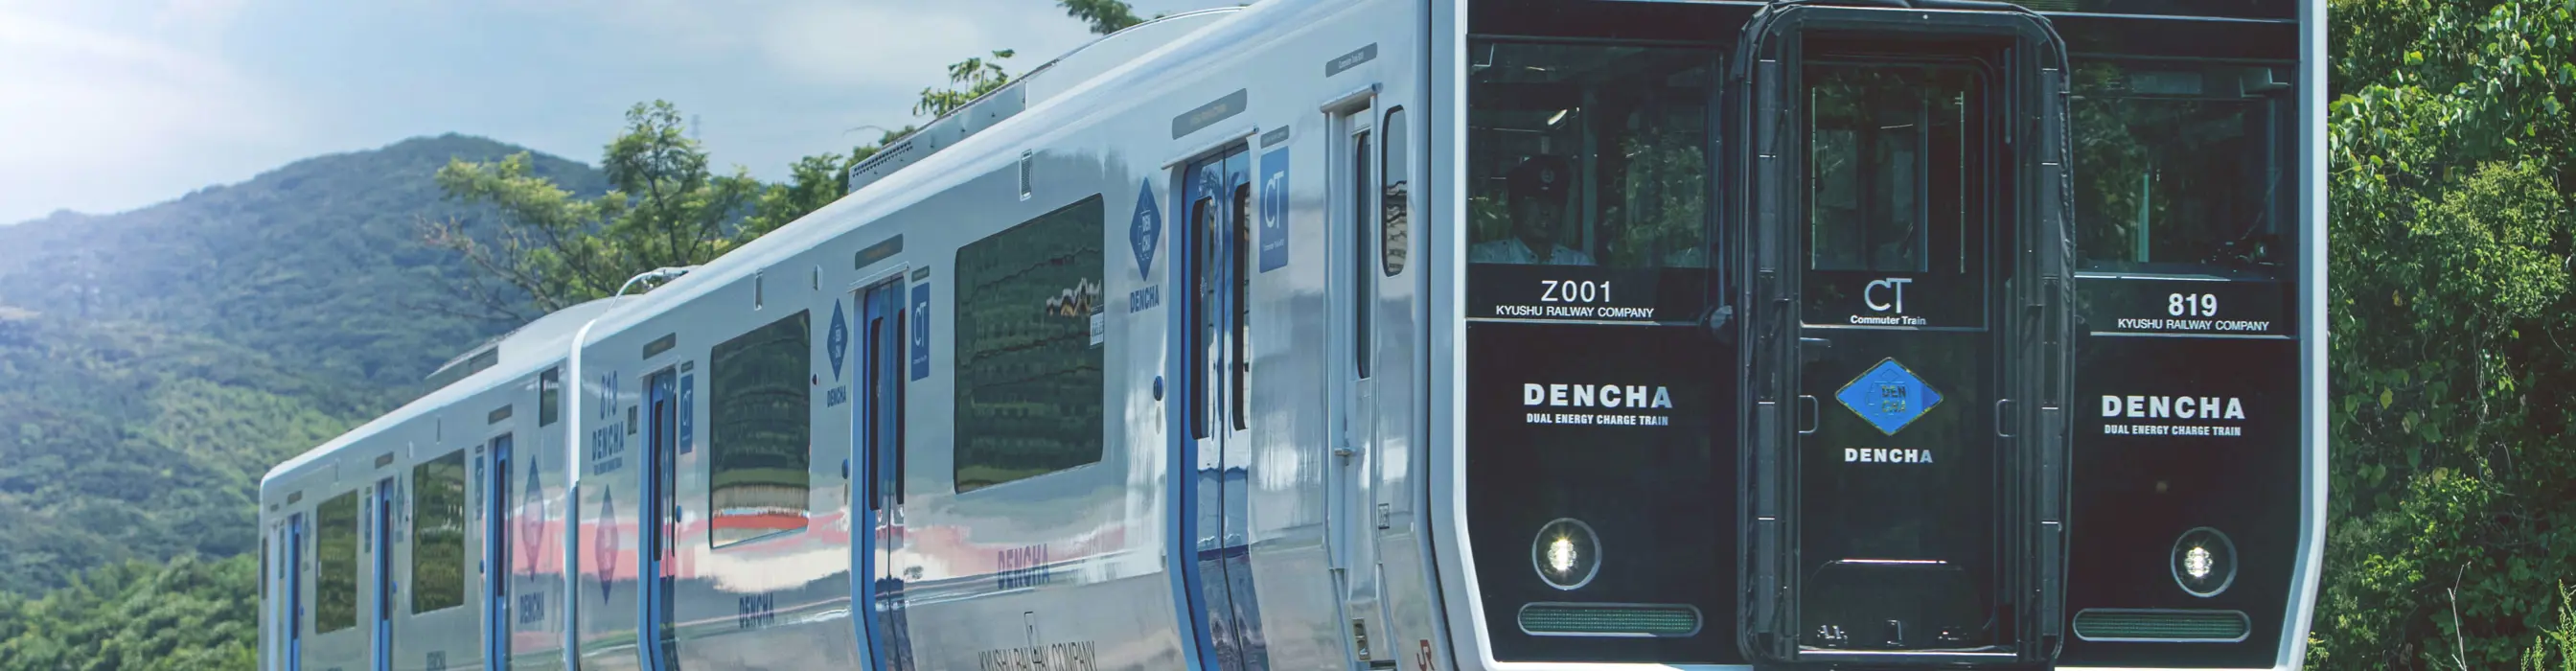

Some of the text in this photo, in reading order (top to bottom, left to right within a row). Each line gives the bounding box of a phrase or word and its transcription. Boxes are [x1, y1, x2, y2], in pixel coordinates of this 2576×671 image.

[1264, 170, 1285, 229] CT
[1130, 285, 1160, 313] DENCHA
[1541, 280, 1611, 303] Z001
[1864, 277, 1913, 313] CT
[1496, 305, 1655, 318] KYUSHU RAILWAY COMPANY
[2168, 292, 2219, 317] 819
[914, 301, 927, 347] CT
[1850, 314, 1926, 326] Commuter Train
[2118, 318, 2270, 332] KYUSHU RAILWAY COMPANY
[1524, 383, 1673, 408] DENCHA
[2102, 395, 2246, 420] DENCHA
[1526, 413, 1669, 427] DUAL ENERGY CHARGE TRAIN
[2104, 425, 2242, 436] DUAL ENERGY CHARGE TRAIN
[592, 421, 625, 461] DENCHA
[1845, 448, 1934, 463] DENCHA
[998, 544, 1050, 590] DENCHA
[739, 590, 775, 629] DENCHA
[1051, 640, 1098, 671] COMPANY
